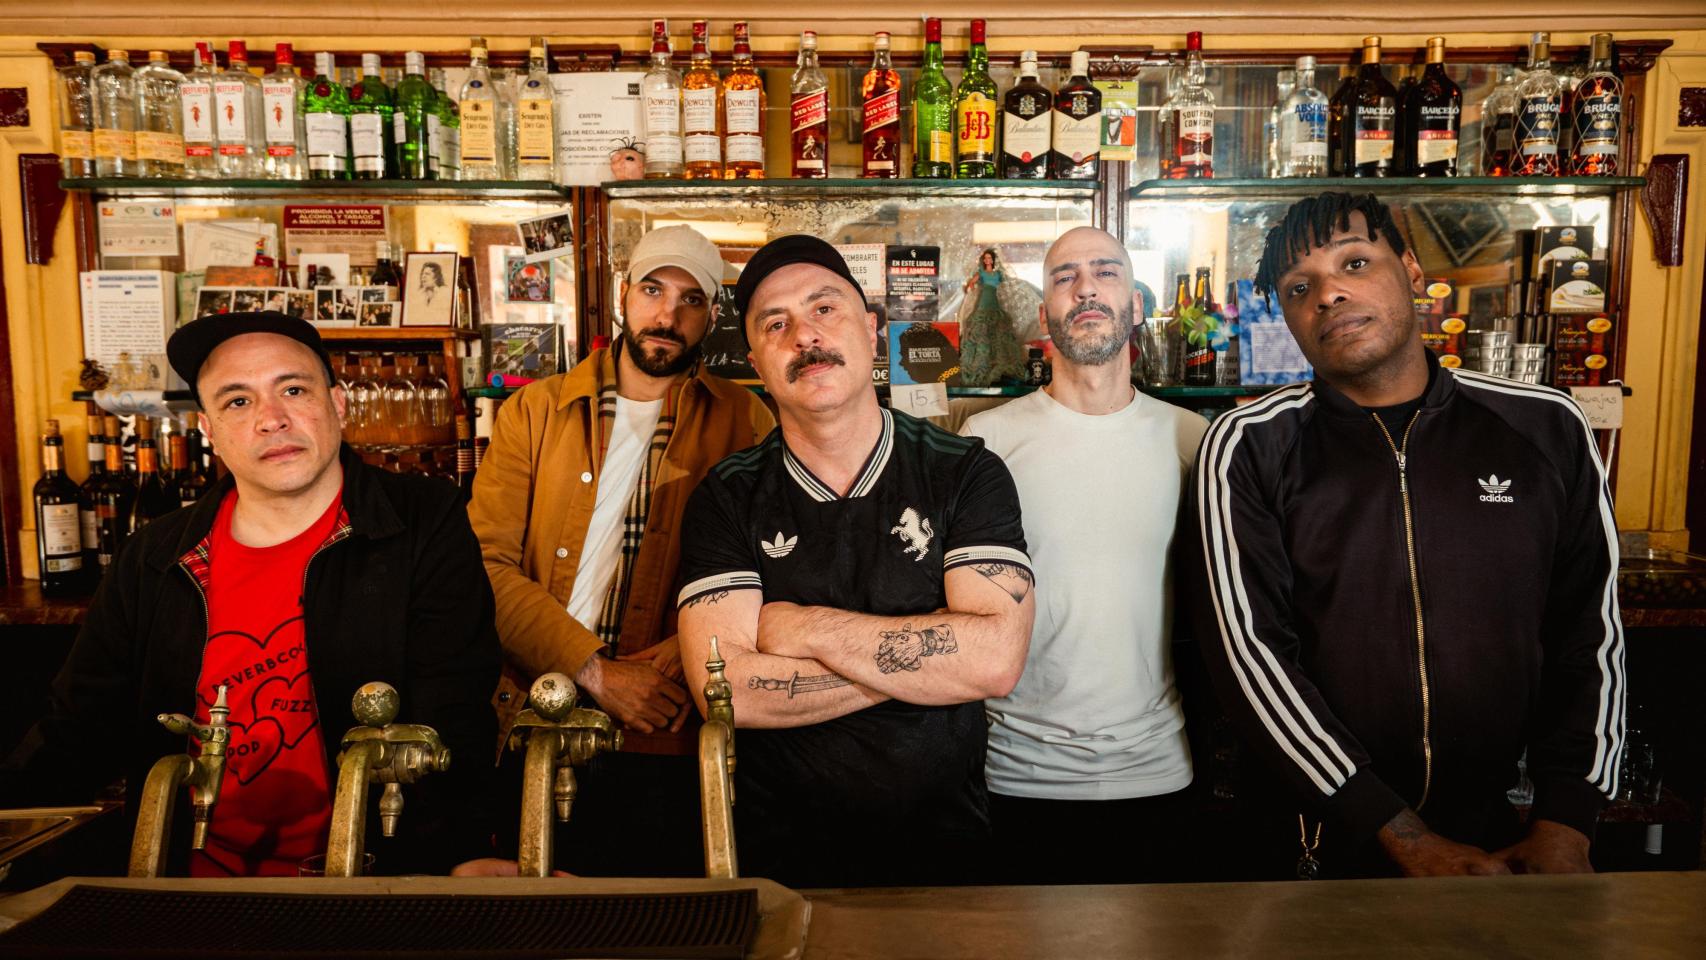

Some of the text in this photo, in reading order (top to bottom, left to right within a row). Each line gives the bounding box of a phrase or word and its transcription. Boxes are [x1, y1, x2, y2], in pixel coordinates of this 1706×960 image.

[794, 101, 826, 117] RED LABEL
[865, 100, 898, 117] RED LABEL
[1358, 105, 1395, 115] BARCELÓ
[1421, 104, 1460, 115] BARCELÓ
[1182, 109, 1213, 119] SOUTHERN
[961, 111, 991, 140] J&B
[1184, 119, 1212, 128] COMFORT
[909, 351, 941, 359] EL TORTA
[1479, 494, 1514, 503] adidas
[271, 698, 312, 713] FUZZ
